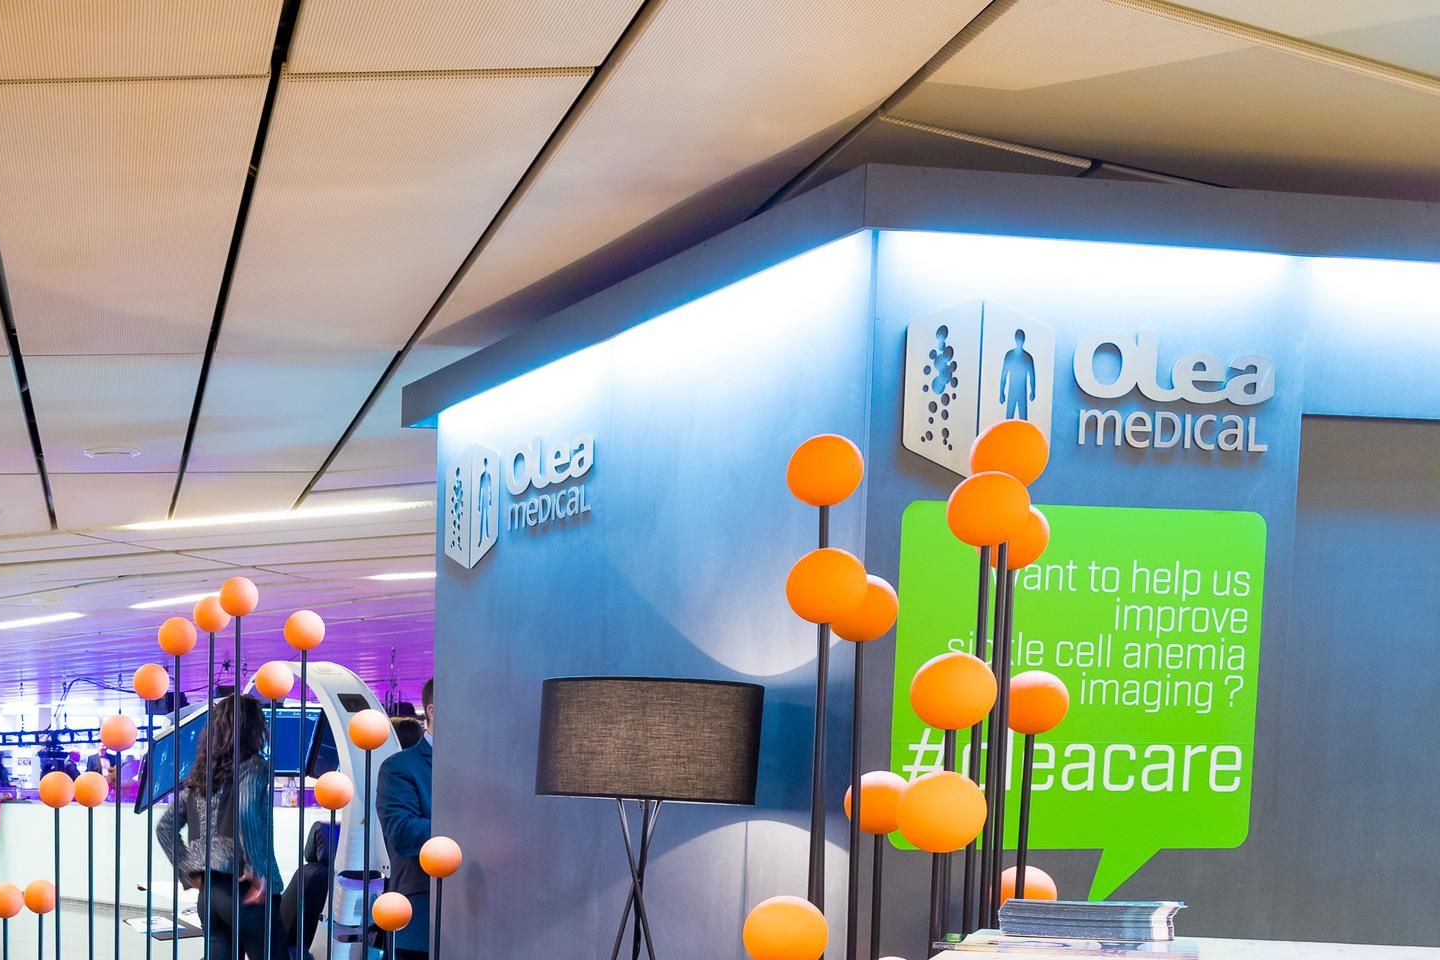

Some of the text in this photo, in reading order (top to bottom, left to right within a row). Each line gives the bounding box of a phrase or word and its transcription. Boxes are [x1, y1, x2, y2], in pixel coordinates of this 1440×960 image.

[1088, 560, 1120, 593] to
[1131, 559, 1201, 602] help
[1213, 569, 1251, 597] us
[1114, 597, 1248, 639] improve
[1056, 633, 1112, 668] cell
[1122, 637, 1245, 671] anemia
[1080, 671, 1244, 714] imaging ?
